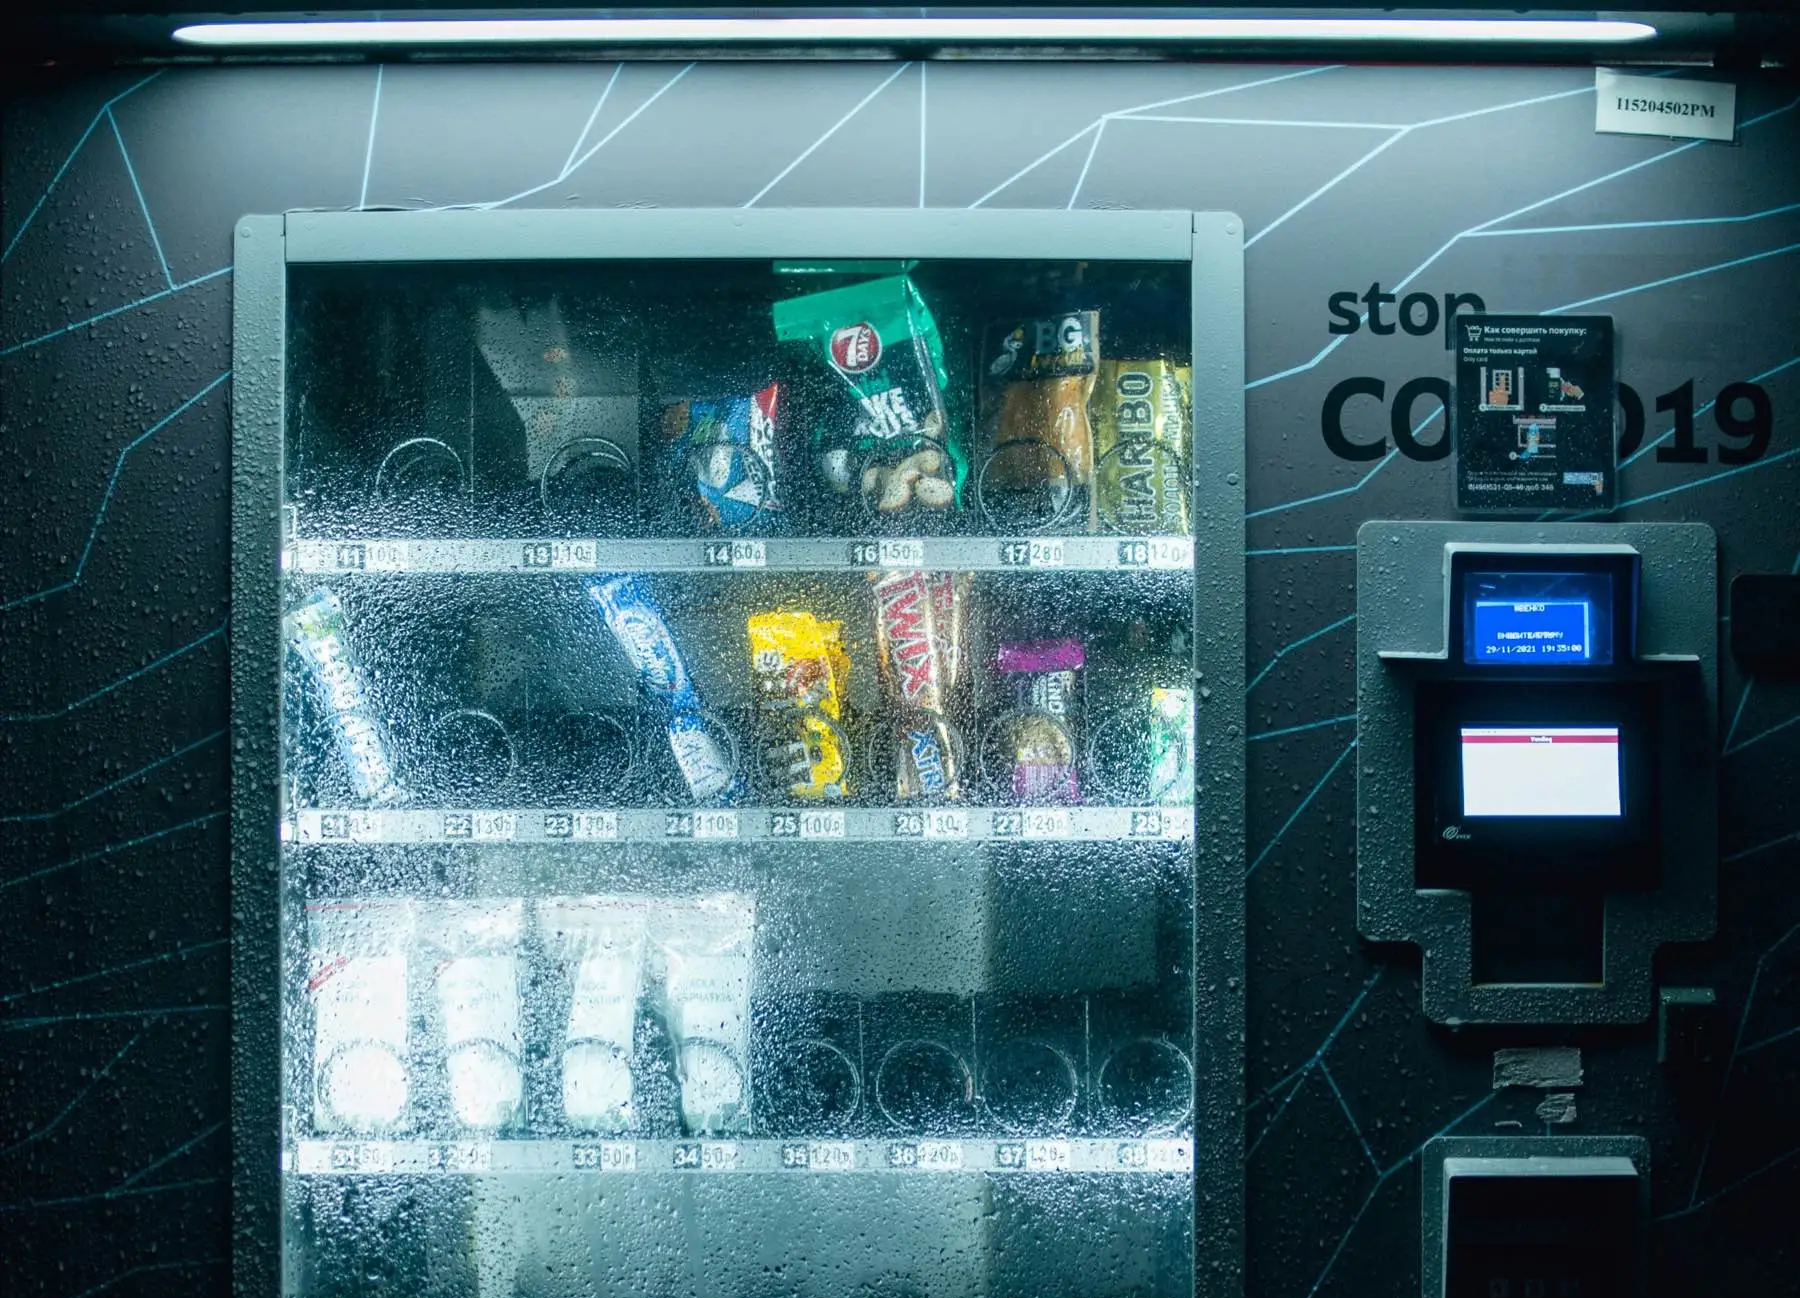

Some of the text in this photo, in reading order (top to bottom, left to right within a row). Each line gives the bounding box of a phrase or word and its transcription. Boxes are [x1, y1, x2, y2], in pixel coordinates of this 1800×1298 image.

[1033, 317, 1083, 353] BG
[1484, 326, 1587, 337] Как совершить покупку:
[1463, 347, 1488, 355] Оплата
[1513, 346, 1538, 356] картой
[1115, 372, 1157, 524] HARIBO
[340, 548, 361, 565] 11
[706, 546, 730, 563] 14
[853, 545, 877, 562] 16
[1007, 544, 1029, 563] 17
[1123, 544, 1147, 562] 18
[873, 570, 935, 700] TWIX
[1486, 645, 1536, 653] 29/11/2021
[1047, 672, 1066, 714] KIND
[446, 817, 472, 836] 22
[546, 816, 571, 835] 23
[667, 815, 692, 835] 24
[773, 815, 798, 834] 25
[897, 816, 922, 833] 26
[997, 815, 1021, 833] 27
[574, 1148, 600, 1166] 33
[675, 1147, 699, 1166] 34
[784, 1147, 808, 1165] 35
[891, 1148, 915, 1165] 36
[999, 1146, 1023, 1164] 37
